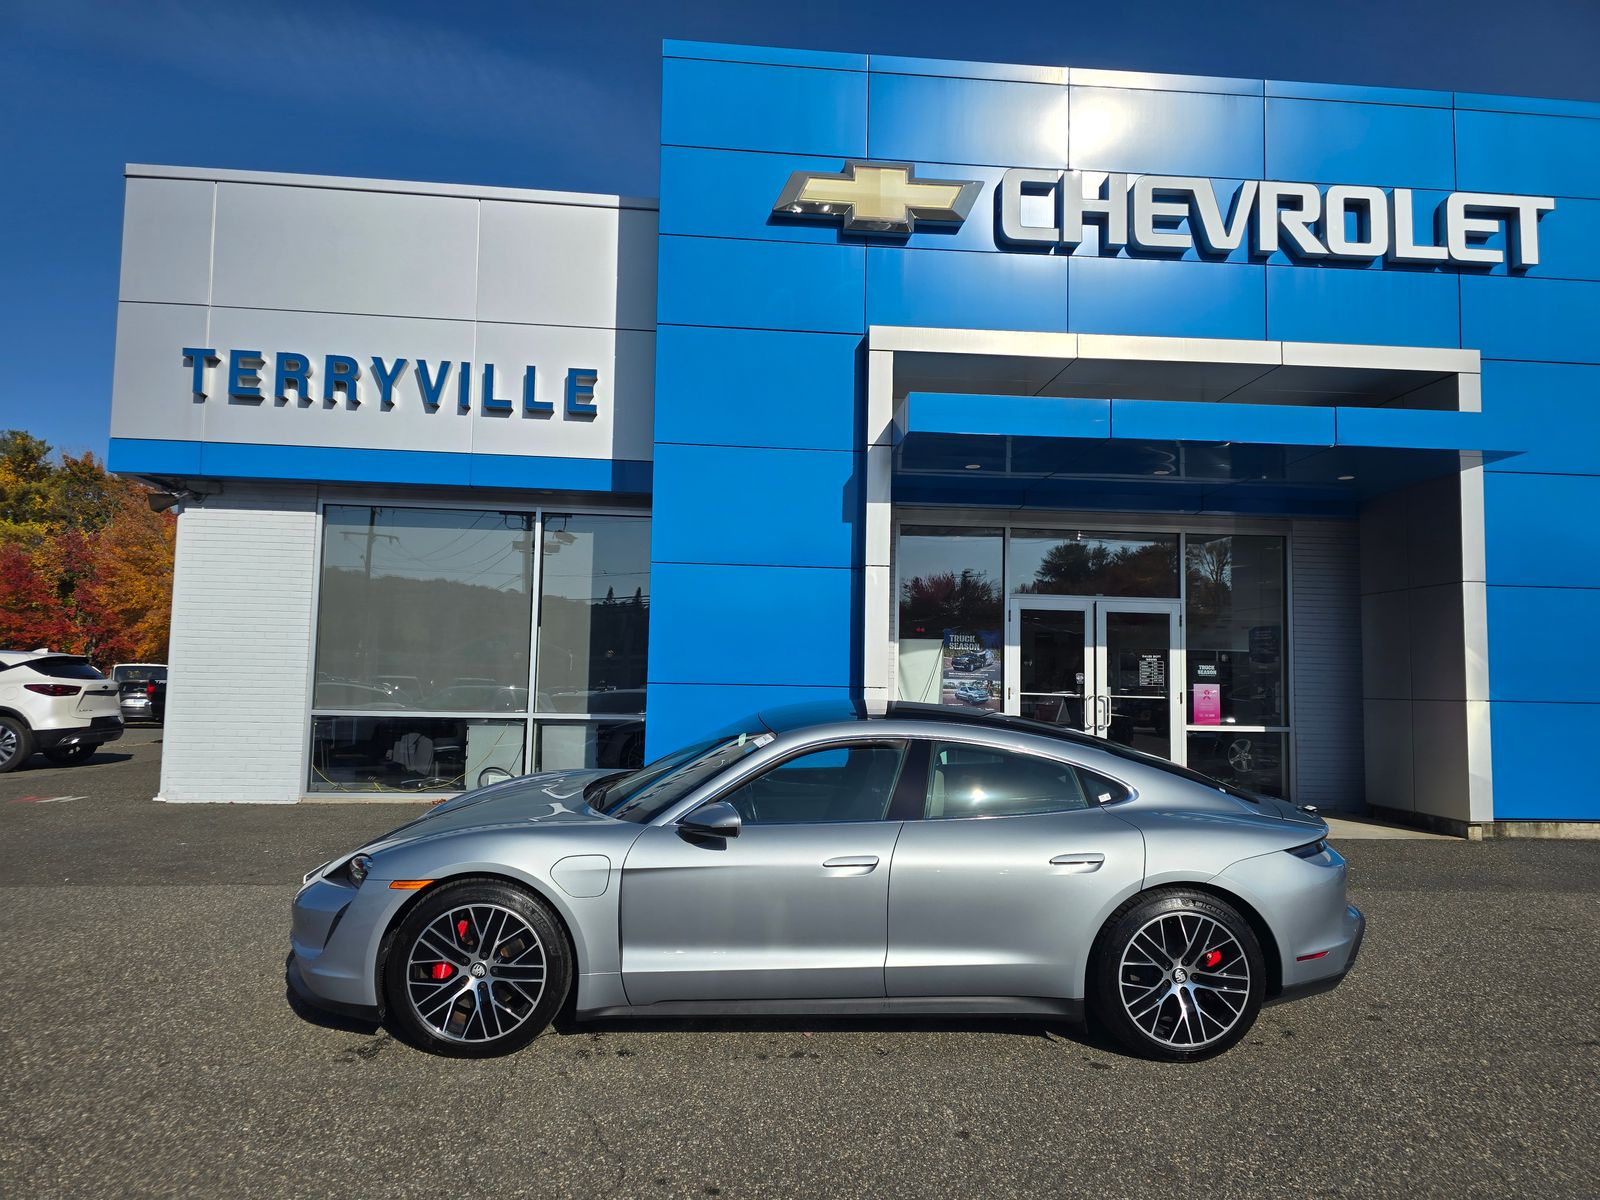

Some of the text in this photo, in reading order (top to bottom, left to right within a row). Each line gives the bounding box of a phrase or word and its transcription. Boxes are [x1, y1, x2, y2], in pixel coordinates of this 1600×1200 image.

[999, 168, 1555, 268] CHEVROLET
[182, 348, 598, 417] TERRYVILLE
[949, 635, 976, 643] TRUCK
[949, 643, 980, 651] SEASON
